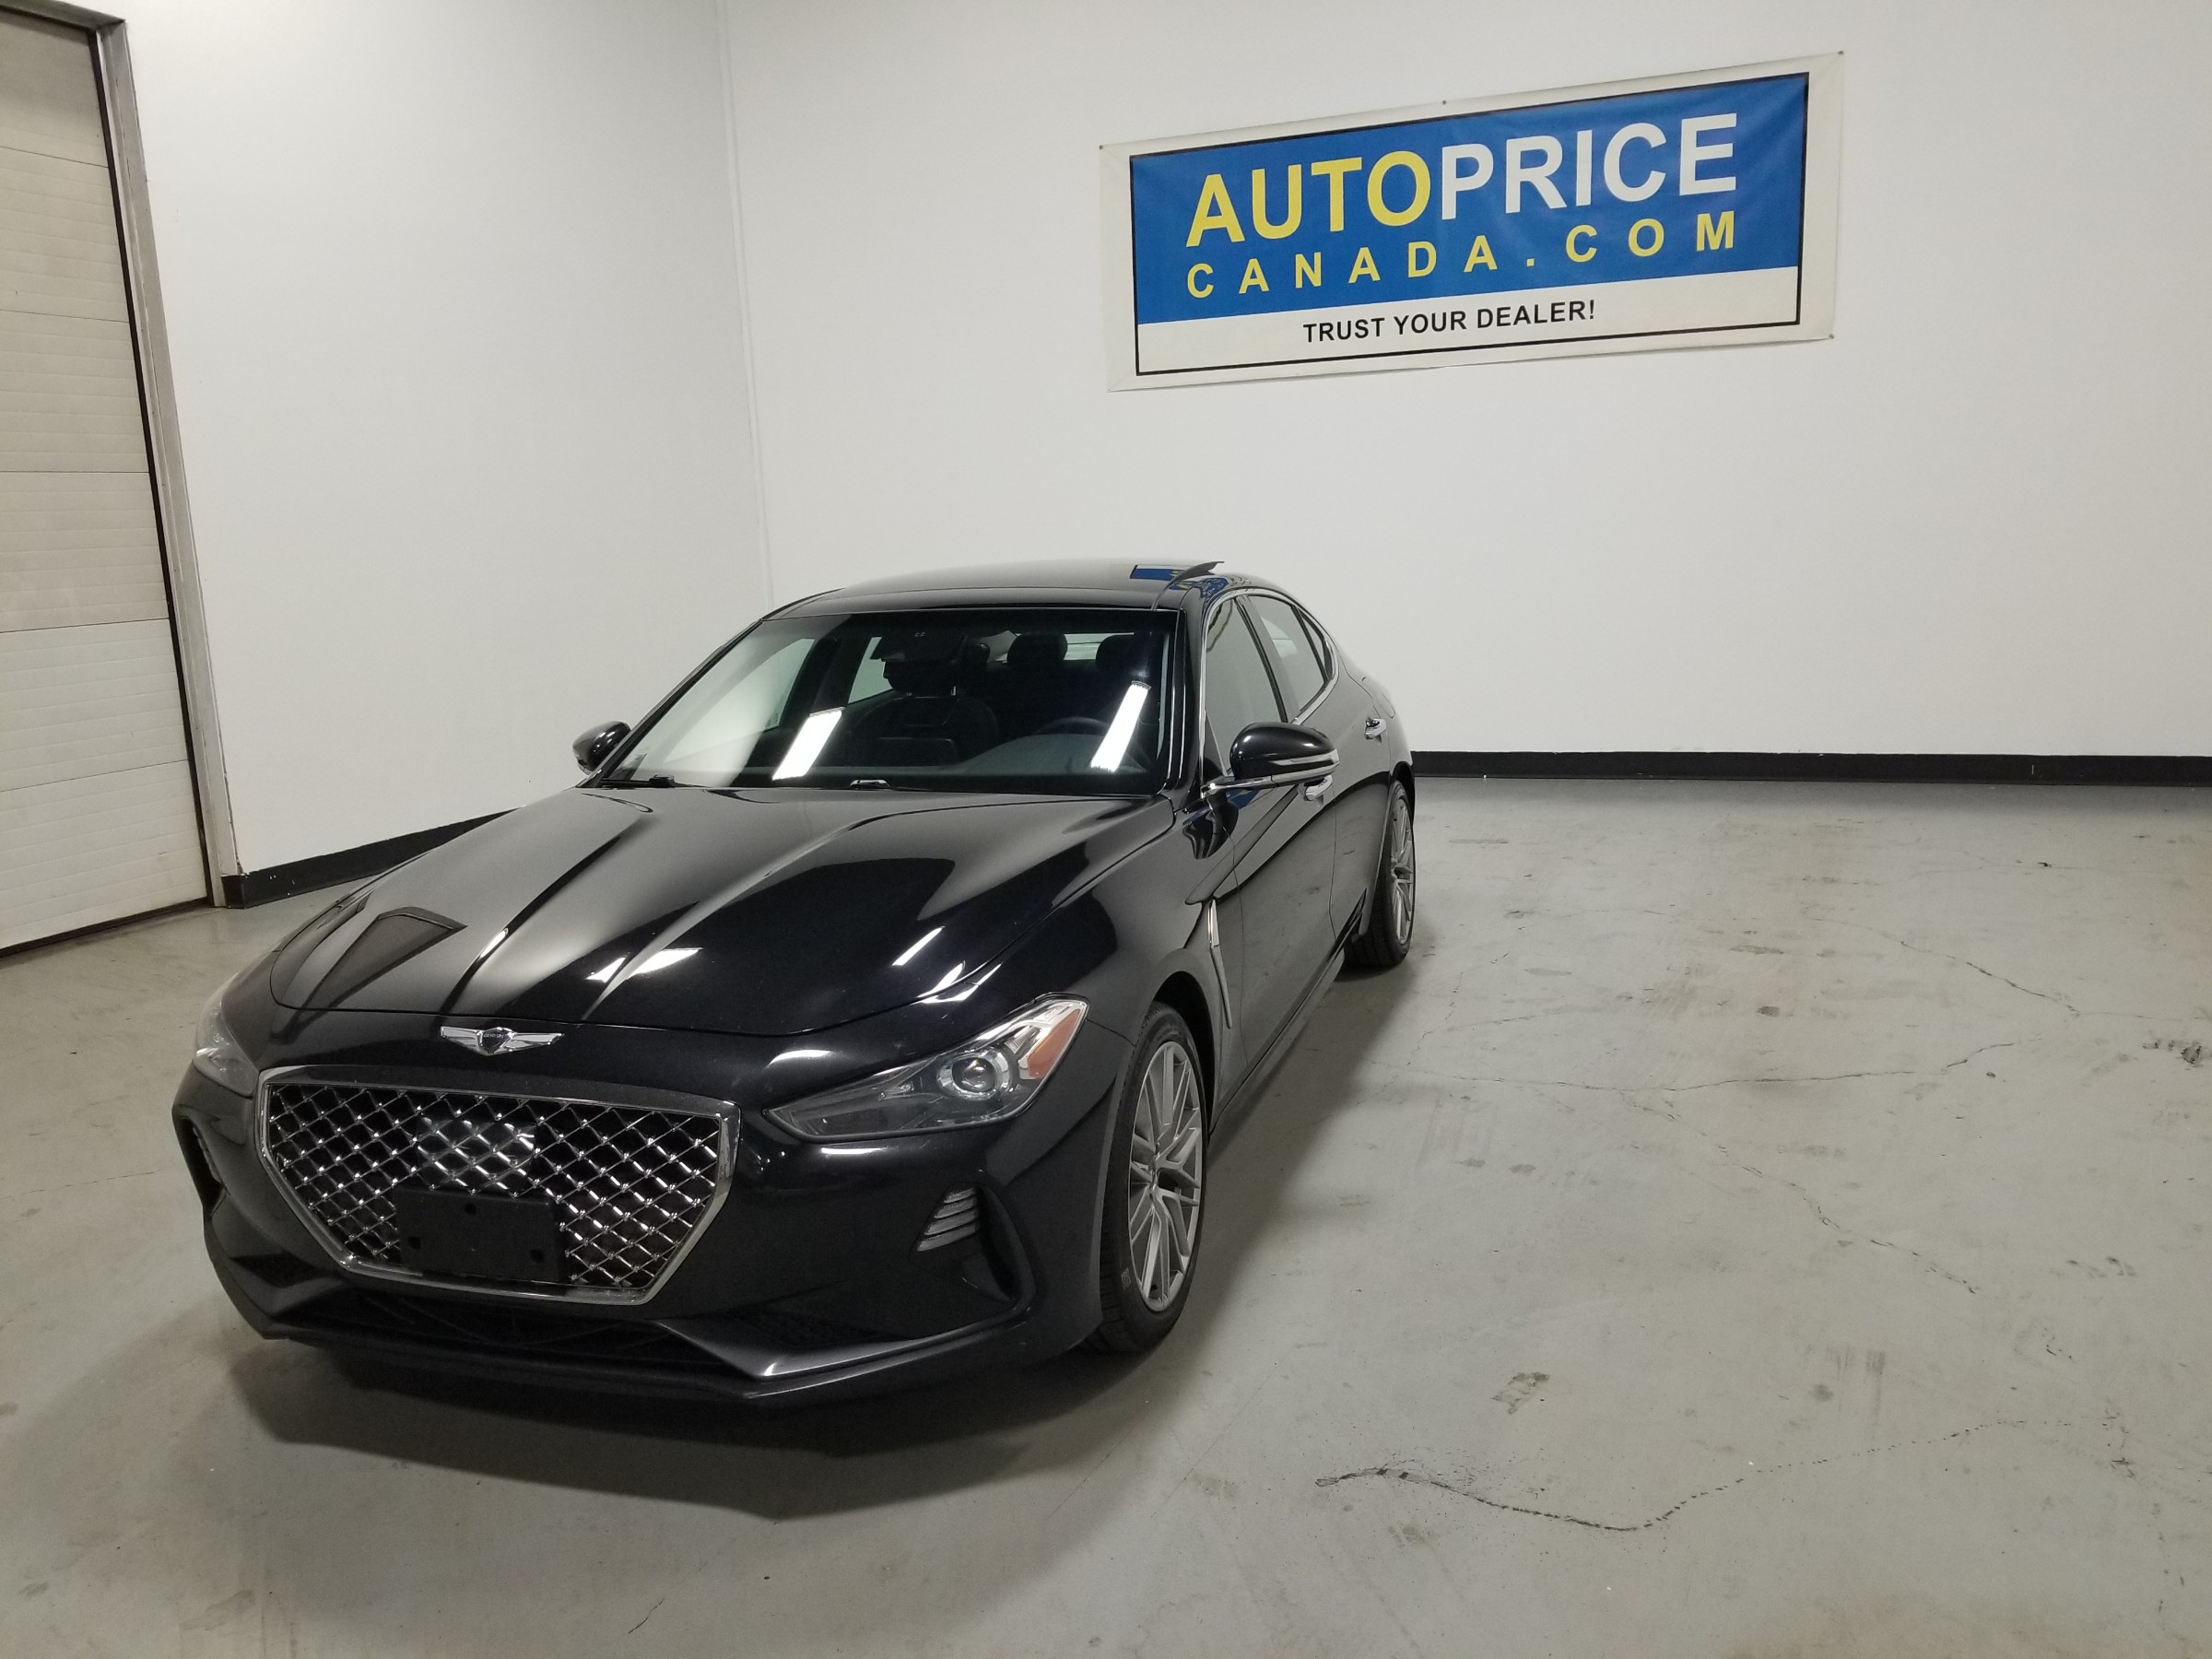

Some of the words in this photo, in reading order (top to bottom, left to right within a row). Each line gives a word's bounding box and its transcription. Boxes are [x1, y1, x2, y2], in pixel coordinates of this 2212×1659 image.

[1186, 113, 1736, 247] AUTOPRICE
[1187, 211, 1735, 298] CANADA.COM
[1303, 318, 1384, 343] TRUST
[1394, 311, 1467, 335] YOUR
[1477, 300, 1594, 328] DEALER!
